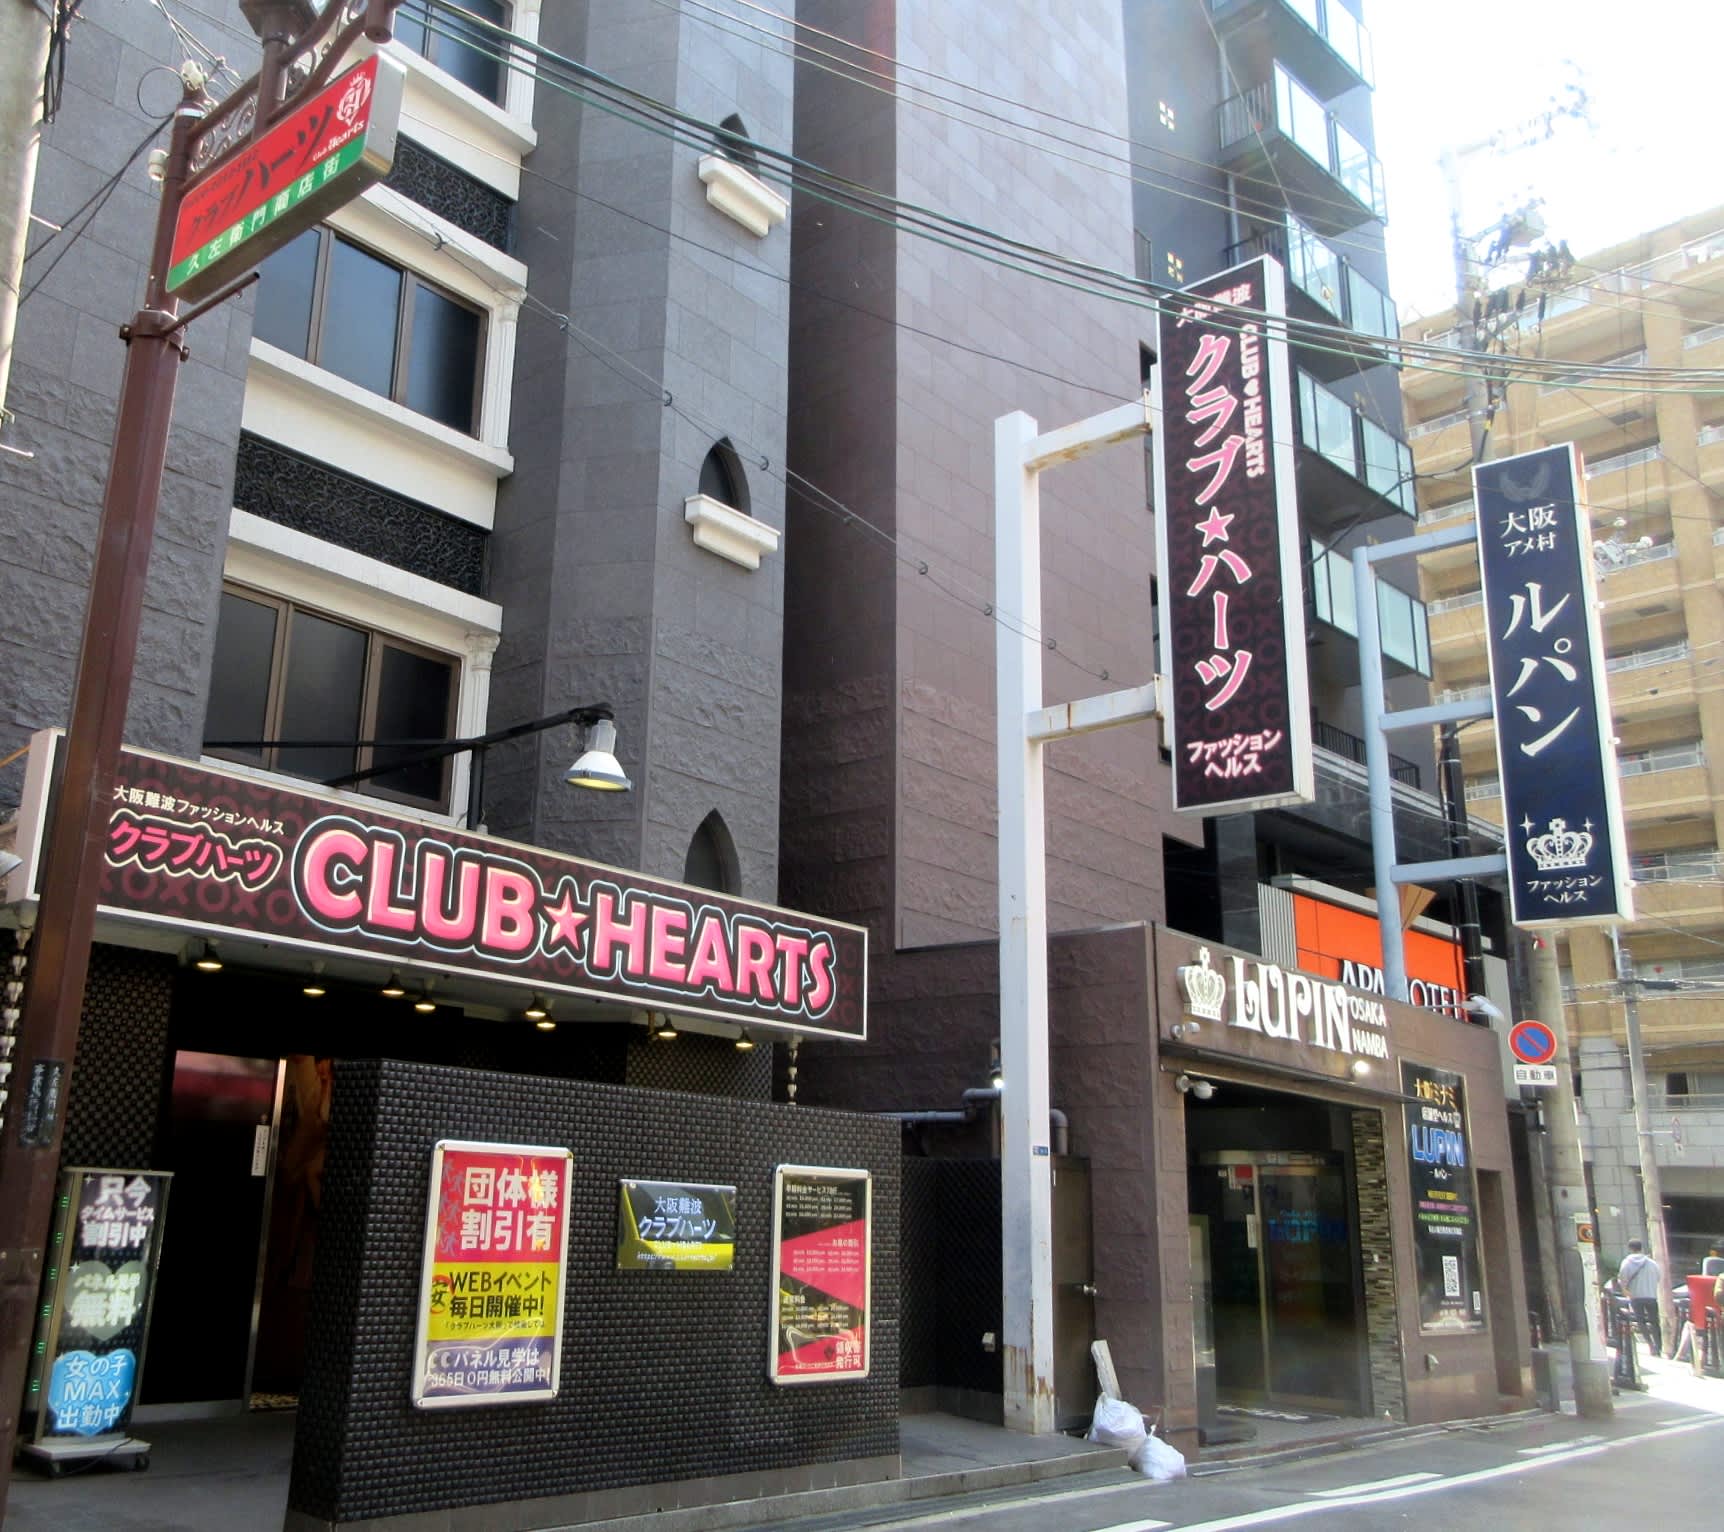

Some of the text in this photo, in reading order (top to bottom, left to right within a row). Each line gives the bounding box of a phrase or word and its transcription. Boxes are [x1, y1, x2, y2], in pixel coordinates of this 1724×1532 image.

[1500, 503, 1557, 539] 大阪
[1504, 531, 1556, 558] アメ村
[1503, 581, 1581, 758] ルパン
[1187, 729, 1283, 764] ファッション
[1204, 753, 1263, 779] ヘルス
[113, 784, 284, 836] 大阪難波ファッションヘルス
[111, 820, 273, 881] クラブハーツ
[1527, 874, 1602, 893] ファッション
[1543, 890, 1588, 905] ヘルス
[1228, 954, 1353, 1055] LUPIN
[1350, 995, 1387, 1027] OSAKA
[1352, 1028, 1389, 1059] NAMBA
[1516, 1069, 1554, 1081] 自動車
[1411, 1123, 1465, 1168] LUPIN
[94, 1175, 151, 1207] 只今
[463, 1166, 558, 1209] 団体様
[80, 1205, 154, 1222] タイムサービス
[654, 1196, 702, 1214] 大阪難波
[81, 1220, 148, 1248] 割引中
[460, 1208, 556, 1251] 割引有
[639, 1215, 716, 1240] クラブハーツ
[449, 1270, 552, 1292] WEBイベント
[70, 1288, 136, 1328] 無料
[449, 1294, 544, 1319] 毎日開催中!
[65, 1354, 127, 1378] 女の子
[454, 1347, 540, 1369] パネル見学は
[64, 1379, 121, 1401] MAX
[57, 1403, 120, 1429] 出勤中
